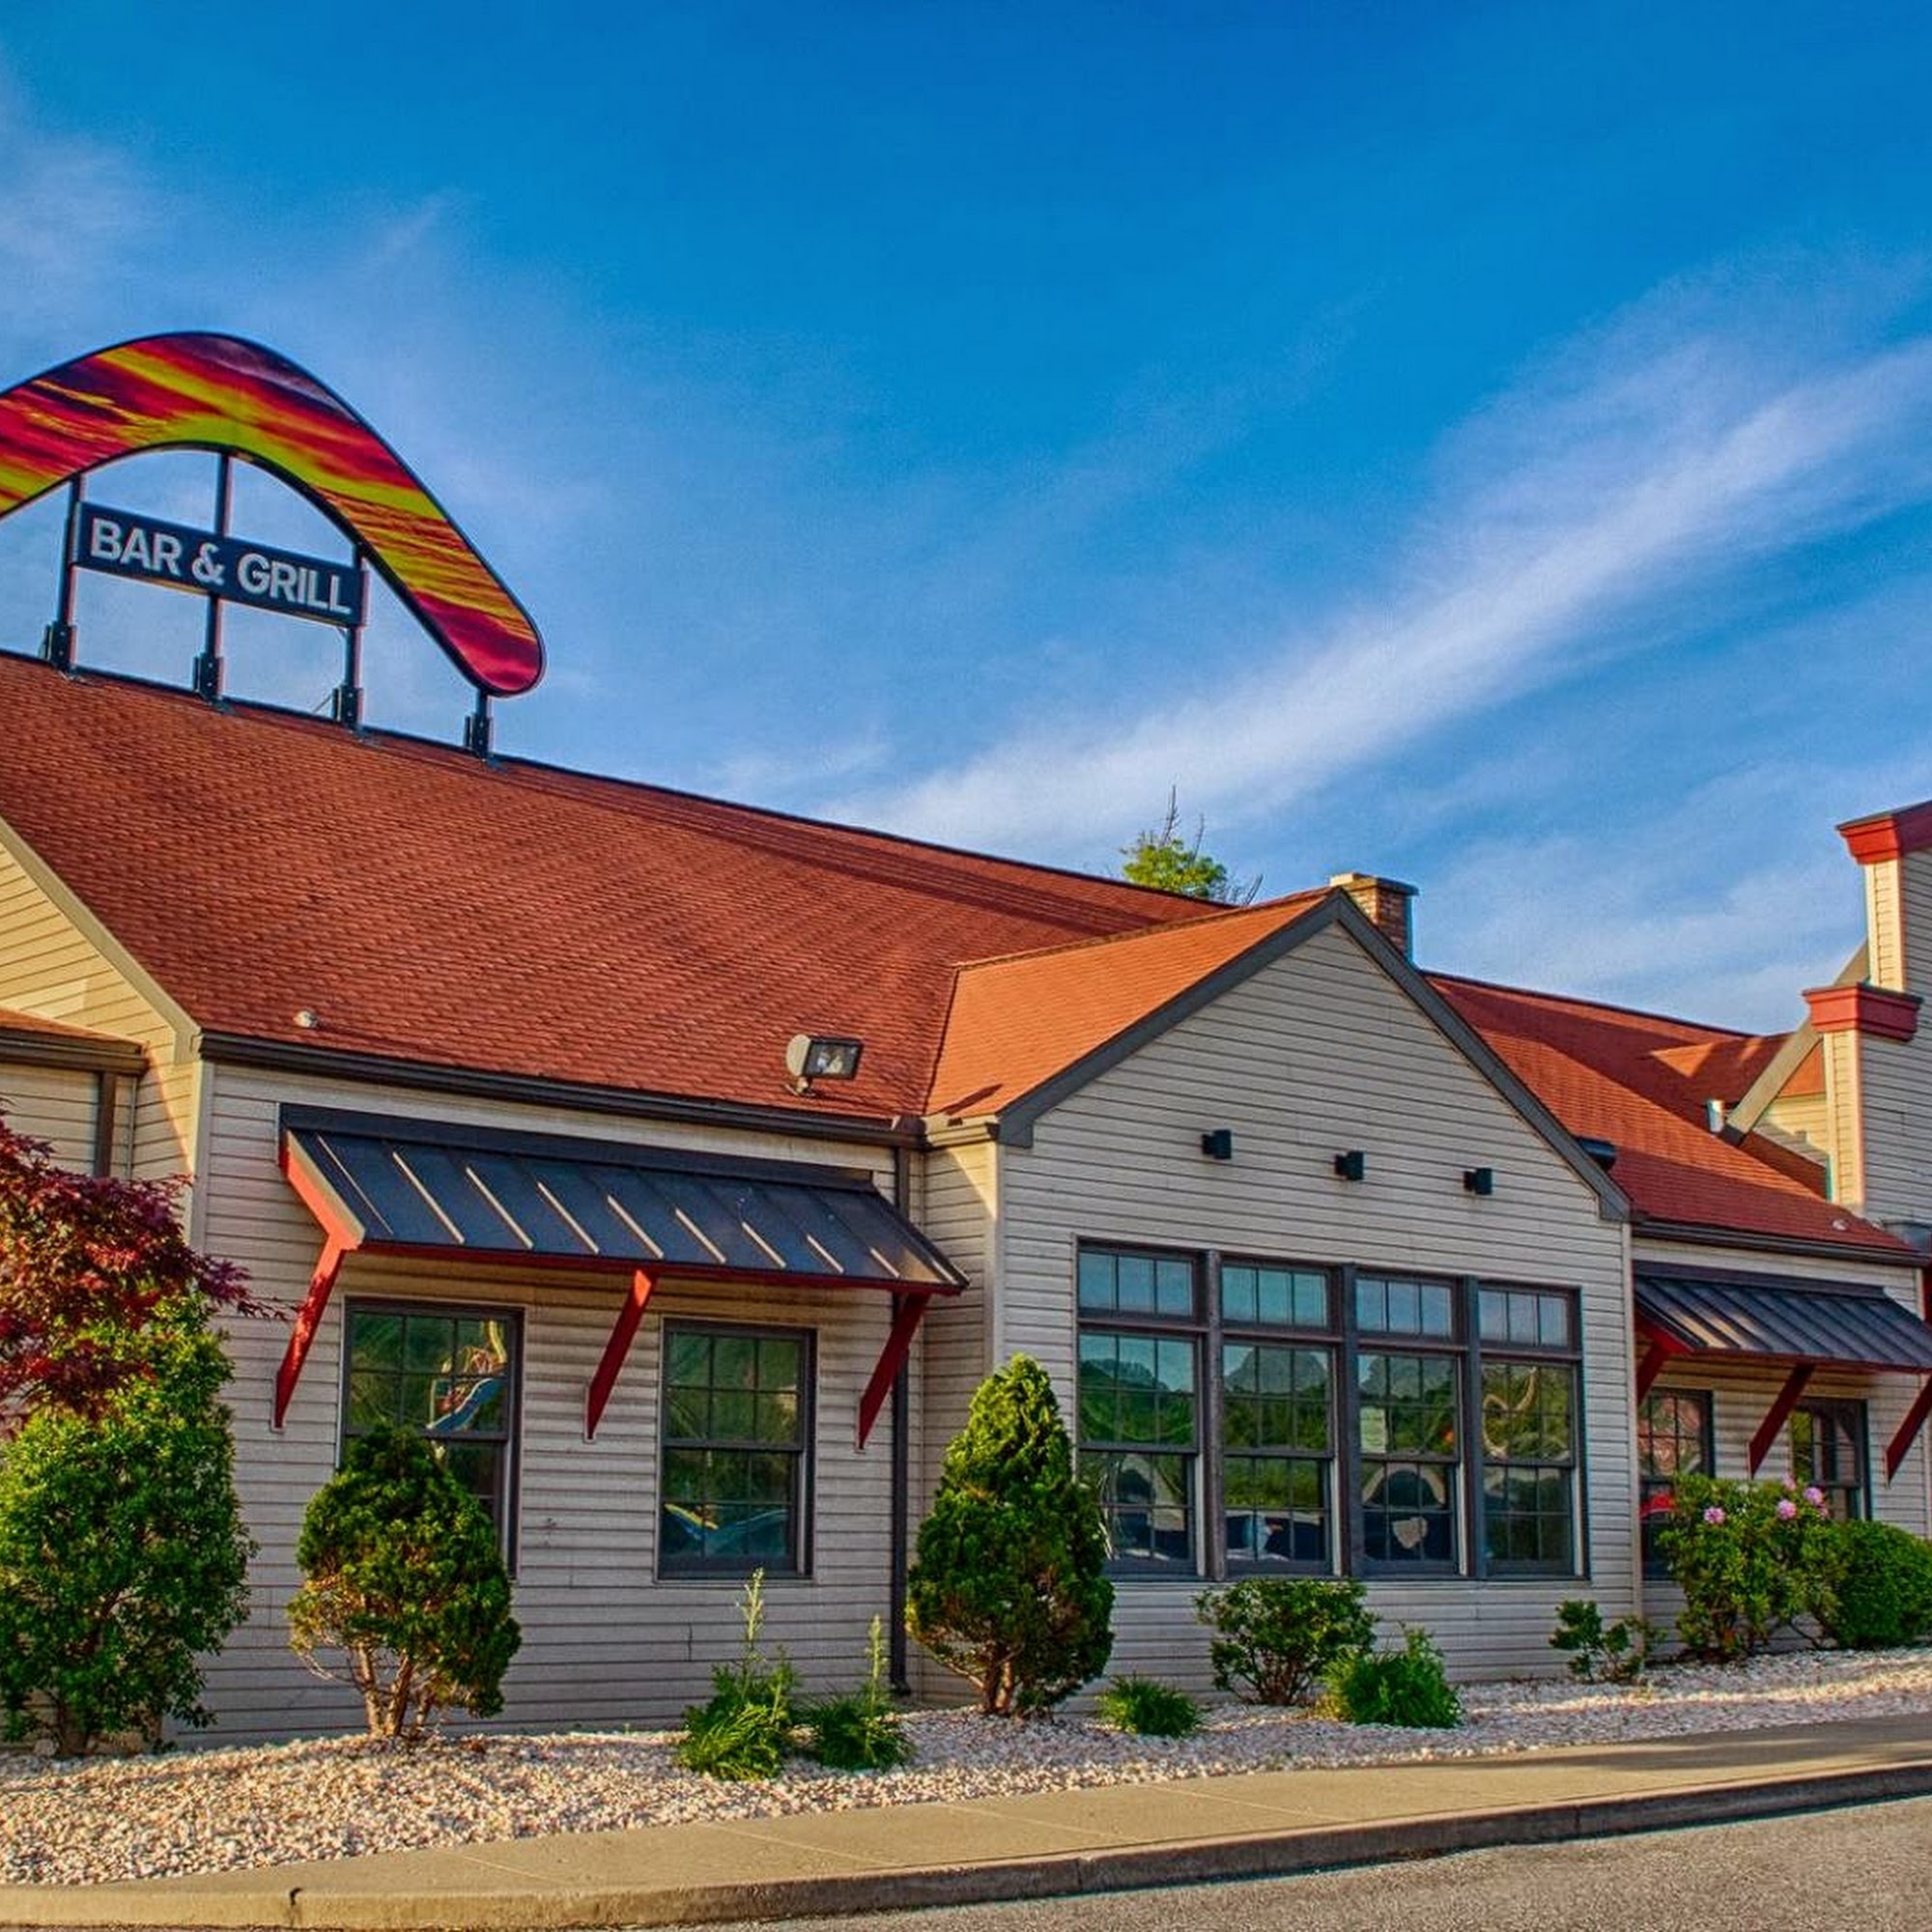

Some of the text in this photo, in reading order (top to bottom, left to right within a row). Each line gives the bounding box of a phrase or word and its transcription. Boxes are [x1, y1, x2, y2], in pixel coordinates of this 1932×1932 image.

[90, 517, 352, 614] BAR & GRILL
